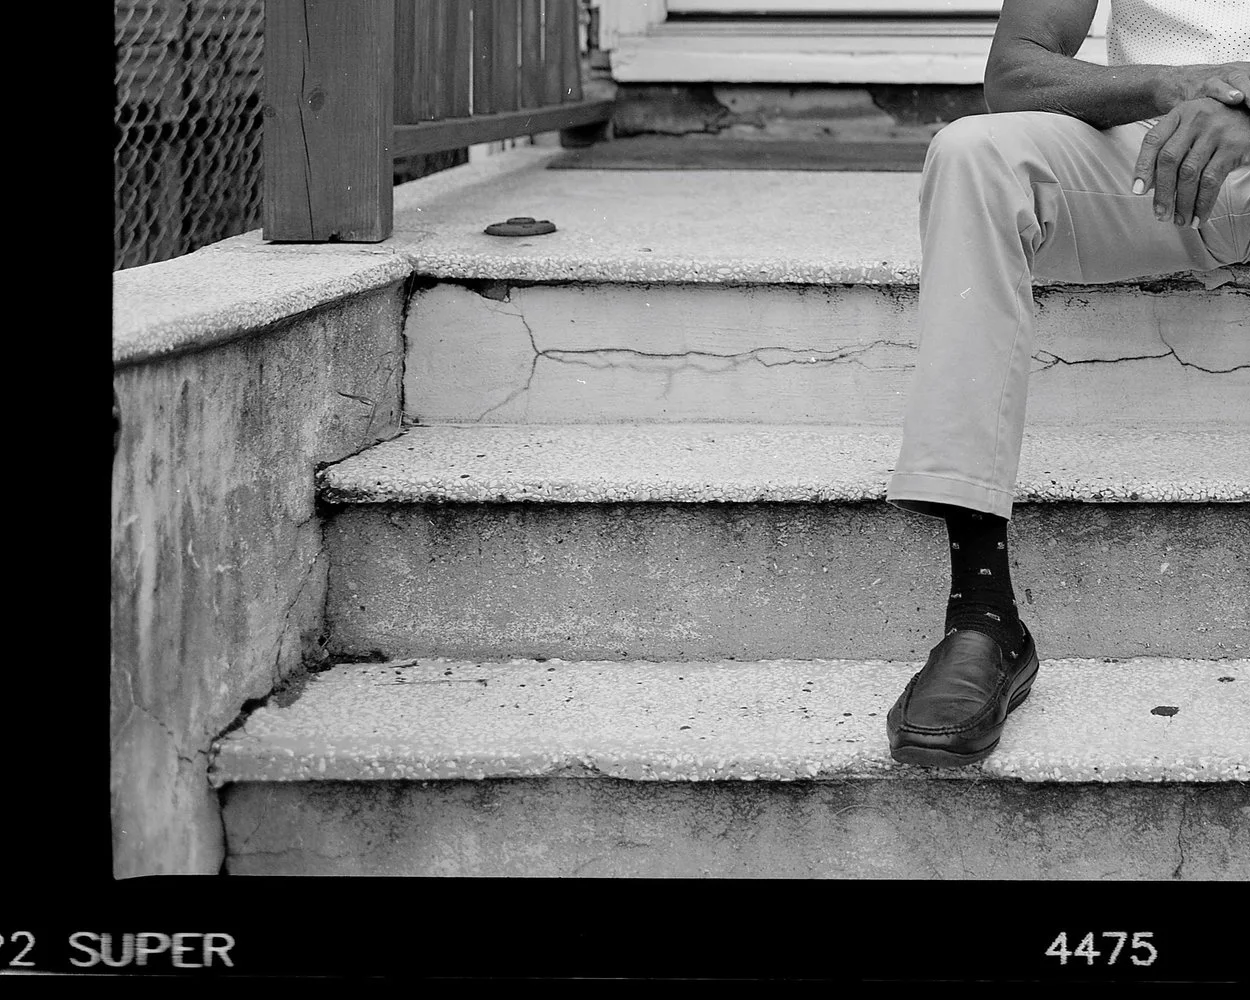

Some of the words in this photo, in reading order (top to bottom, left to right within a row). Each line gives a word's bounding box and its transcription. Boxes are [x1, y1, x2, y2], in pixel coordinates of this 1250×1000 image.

[0, 930, 36, 967] 2
[68, 931, 236, 968] SUPER
[1044, 931, 1158, 967] 4475
